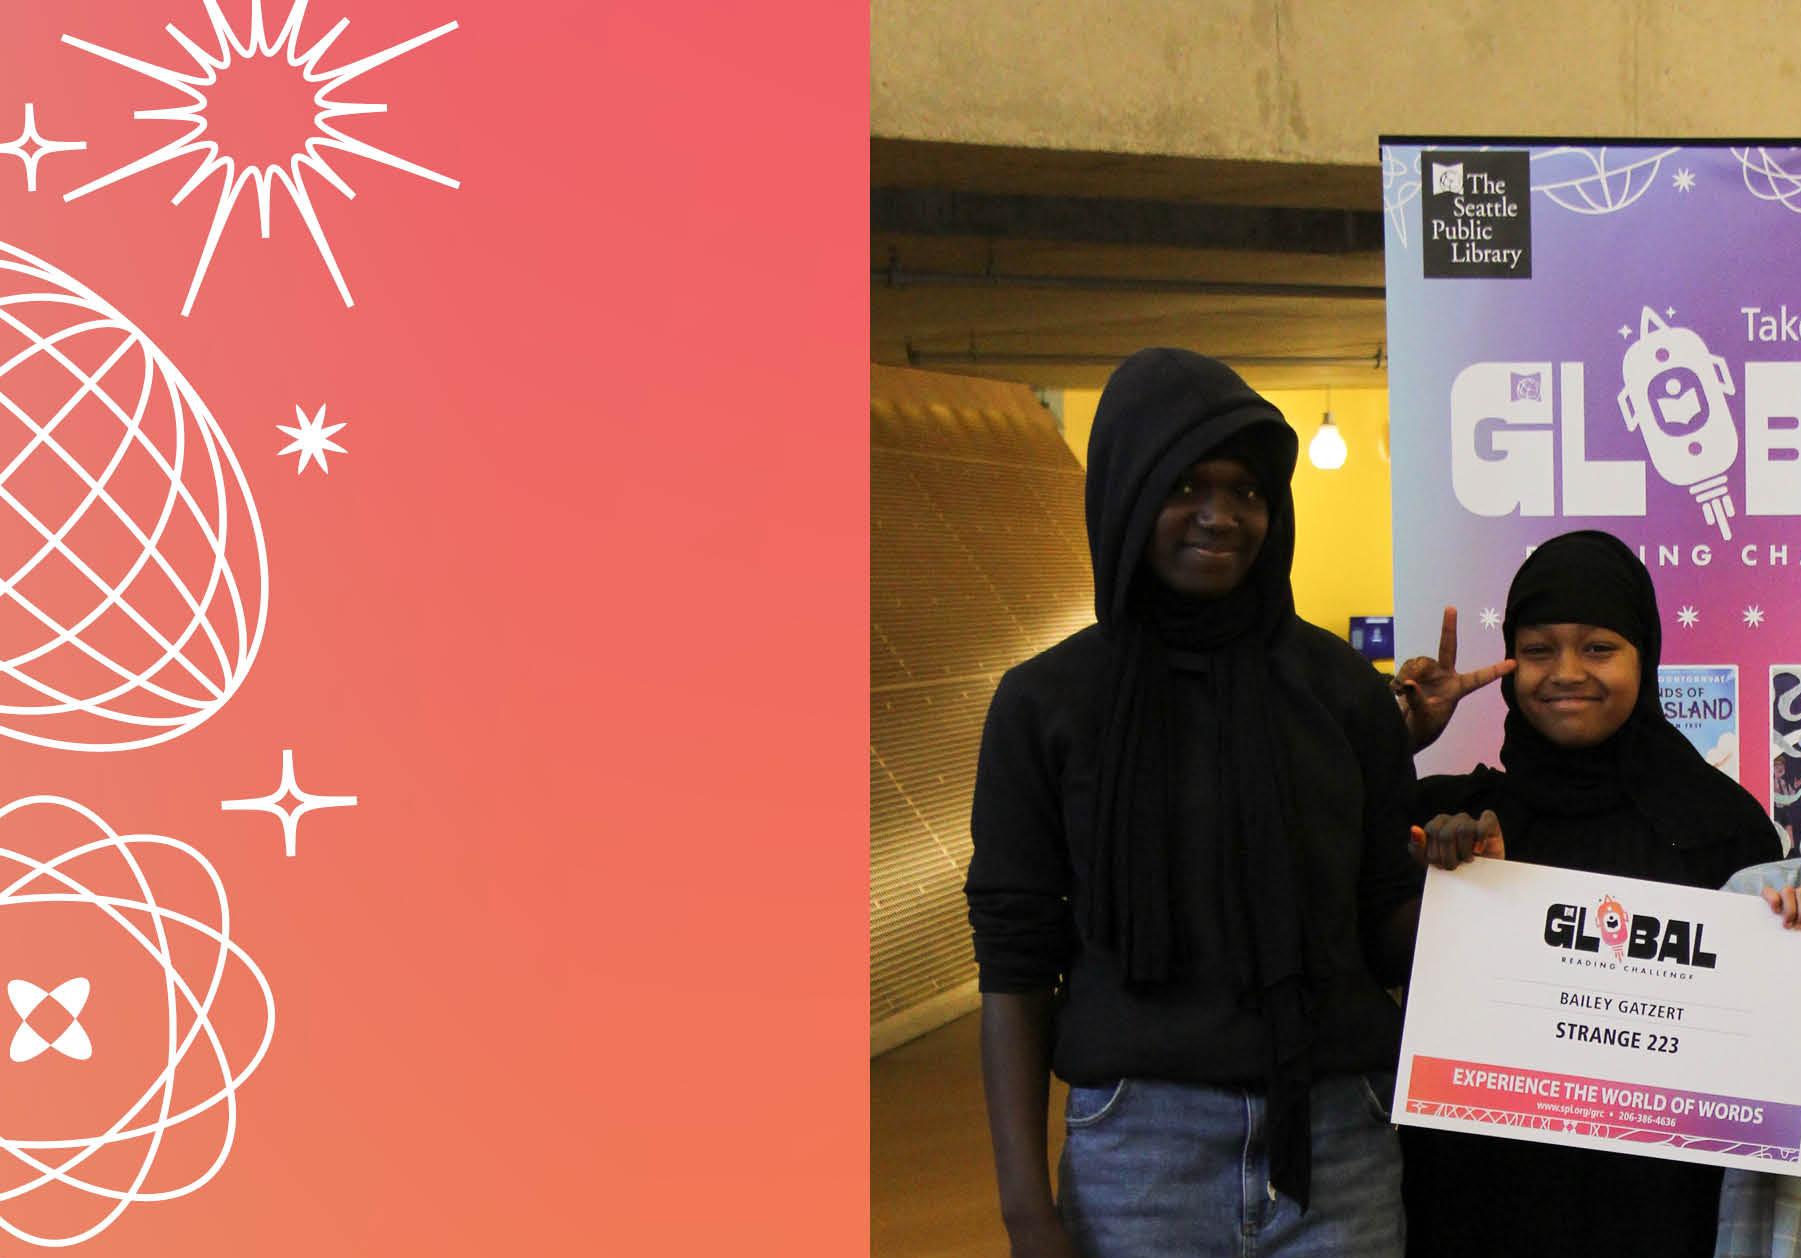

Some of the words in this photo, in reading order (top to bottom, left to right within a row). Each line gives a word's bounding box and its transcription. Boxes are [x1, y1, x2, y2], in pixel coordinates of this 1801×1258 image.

[1467, 173, 1506, 194] The
[1453, 196, 1518, 217] Seattle
[1432, 219, 1493, 240] Public
[1451, 241, 1522, 269] Library
[1687, 687, 1705, 697] OF
[1663, 697, 1733, 720] SLAND
[1544, 903, 1717, 969] GLOBAL
[1561, 956, 1616, 970] READING
[1623, 965, 1694, 980] CHALLENGE
[1560, 991, 1613, 1011] BAILEY
[1618, 1000, 1685, 1021] GATZERT
[1555, 1021, 1642, 1049] STRANGE
[1646, 1033, 1679, 1055] 223
[1452, 1067, 1560, 1098] EXPERIENCE
[1564, 1082, 1598, 1103] THE
[1601, 1086, 1666, 1112] WORLD
[1671, 1096, 1695, 1116] OF
[1698, 1099, 1765, 1125] WORDS
[1536, 1101, 1605, 1119] www.spl.org/grc
[1618, 1111, 1677, 1128] 206-386-4636
